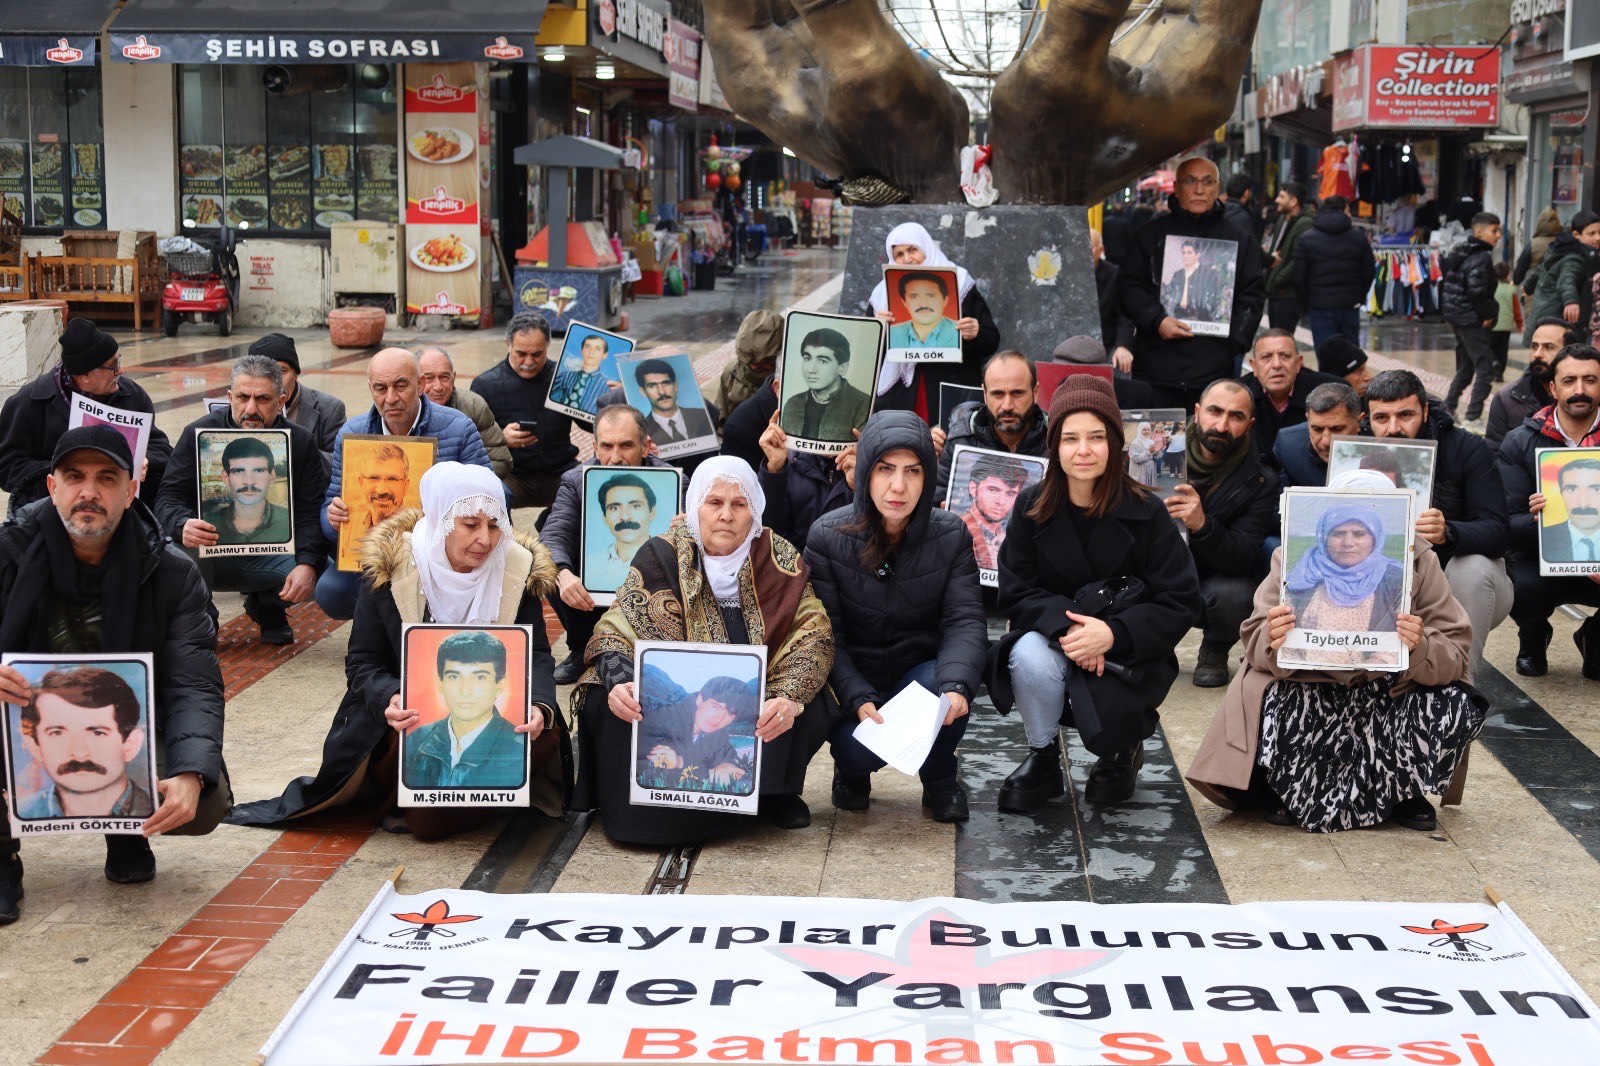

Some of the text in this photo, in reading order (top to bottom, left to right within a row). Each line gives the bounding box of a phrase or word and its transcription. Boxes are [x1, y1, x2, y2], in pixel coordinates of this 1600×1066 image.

[206, 35, 440, 61] ŞEHİR SOFRASI
[1394, 51, 1475, 80] Şirin
[1376, 78, 1490, 96] Collection
[905, 351, 944, 359] İSA GÖK
[78, 400, 144, 426] EDİP ÇELİK
[564, 408, 585, 419] AYDIN
[659, 441, 697, 453] METİN CAN
[795, 440, 826, 451] ÇETİN
[205, 545, 289, 555] MAHMUT DEMİREL
[1549, 565, 1578, 573] M.RACİ
[1304, 632, 1378, 647] Taybet Ana
[413, 791, 516, 804] M.ŞİRİN MALTU
[650, 791, 740, 808] İSMAİL AĞAYA
[21, 820, 144, 833] Medeni GÖKTEP
[504, 919, 1388, 951] Kayıplar Bulunsun
[383, 943, 432, 951] HAKLARI
[333, 963, 1591, 1020] Failler Yargılansın
[378, 1013, 580, 1058] İHD
[623, 1027, 1056, 1064] Batman
